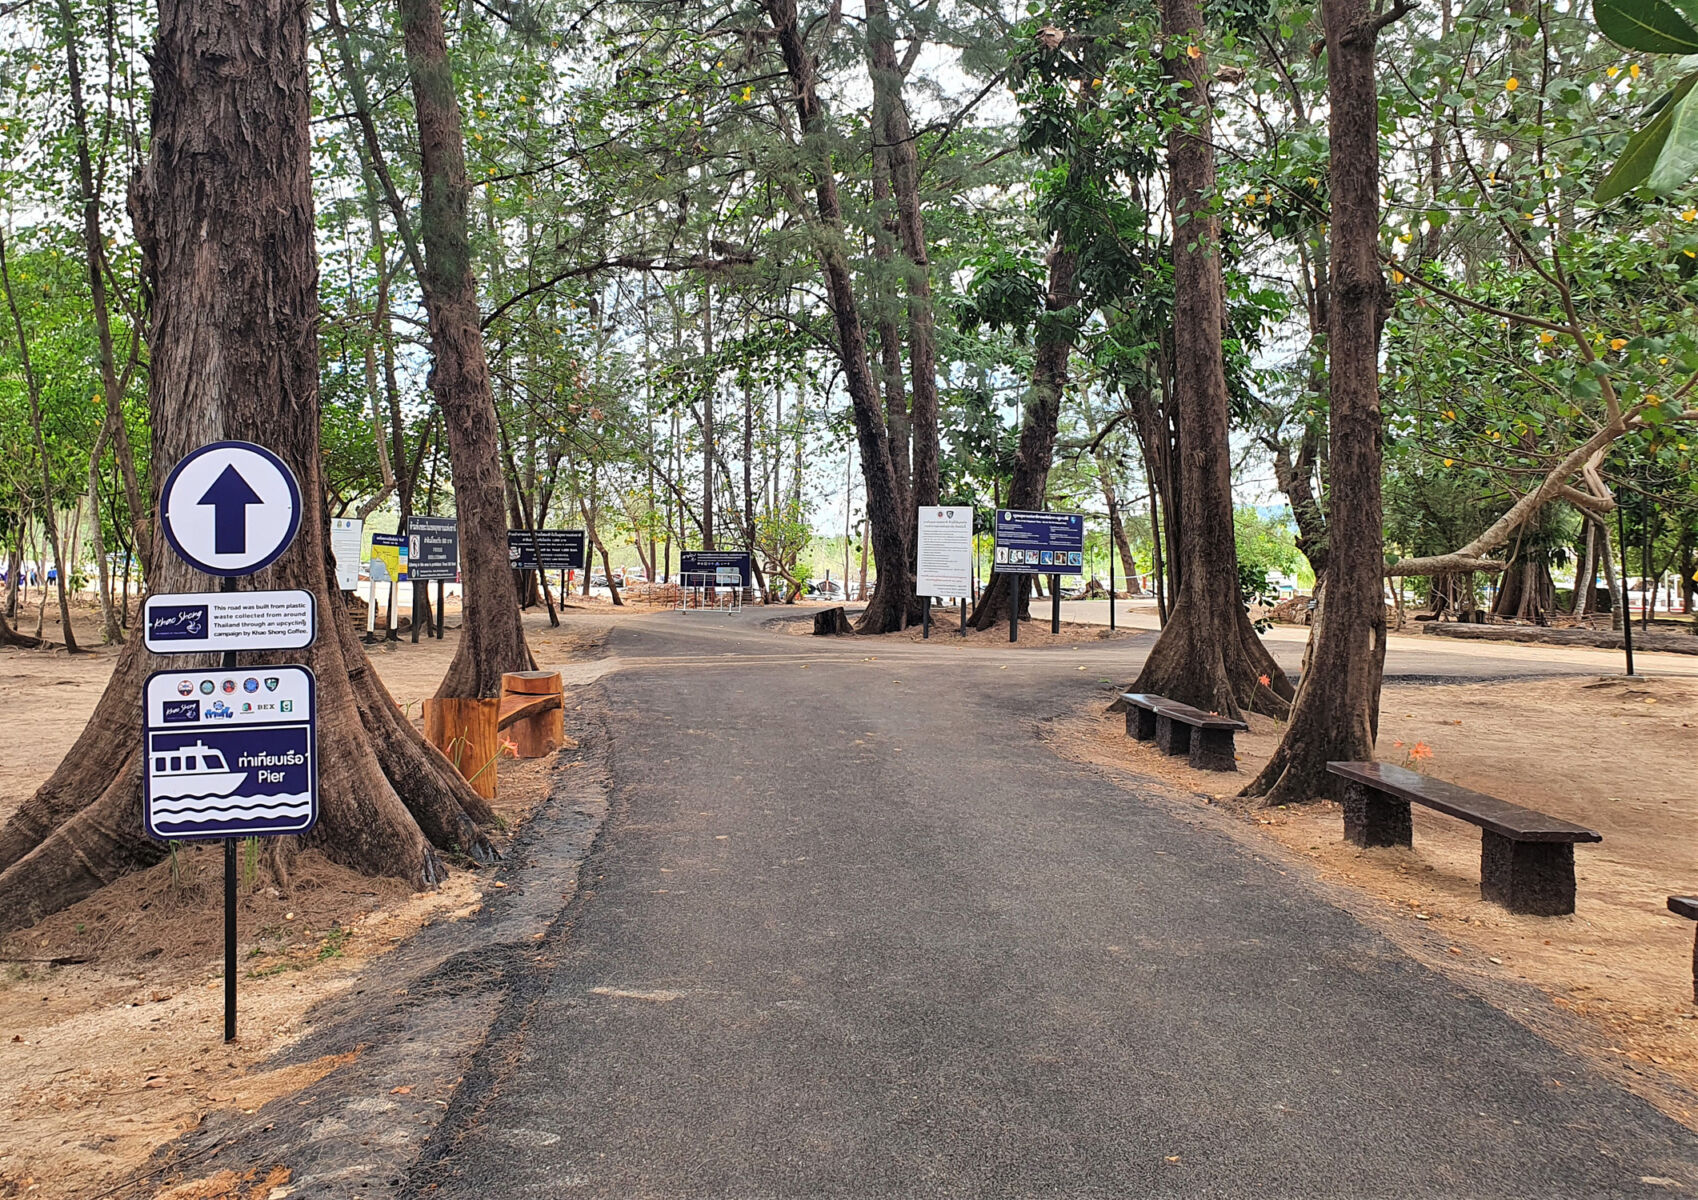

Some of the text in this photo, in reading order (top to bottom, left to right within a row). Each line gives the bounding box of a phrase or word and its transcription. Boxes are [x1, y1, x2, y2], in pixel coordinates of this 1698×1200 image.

[154, 610, 202, 629] Khao Shong
[239, 749, 304, 768] ท่าเทียบเรือ
[258, 769, 286, 784] Pier
